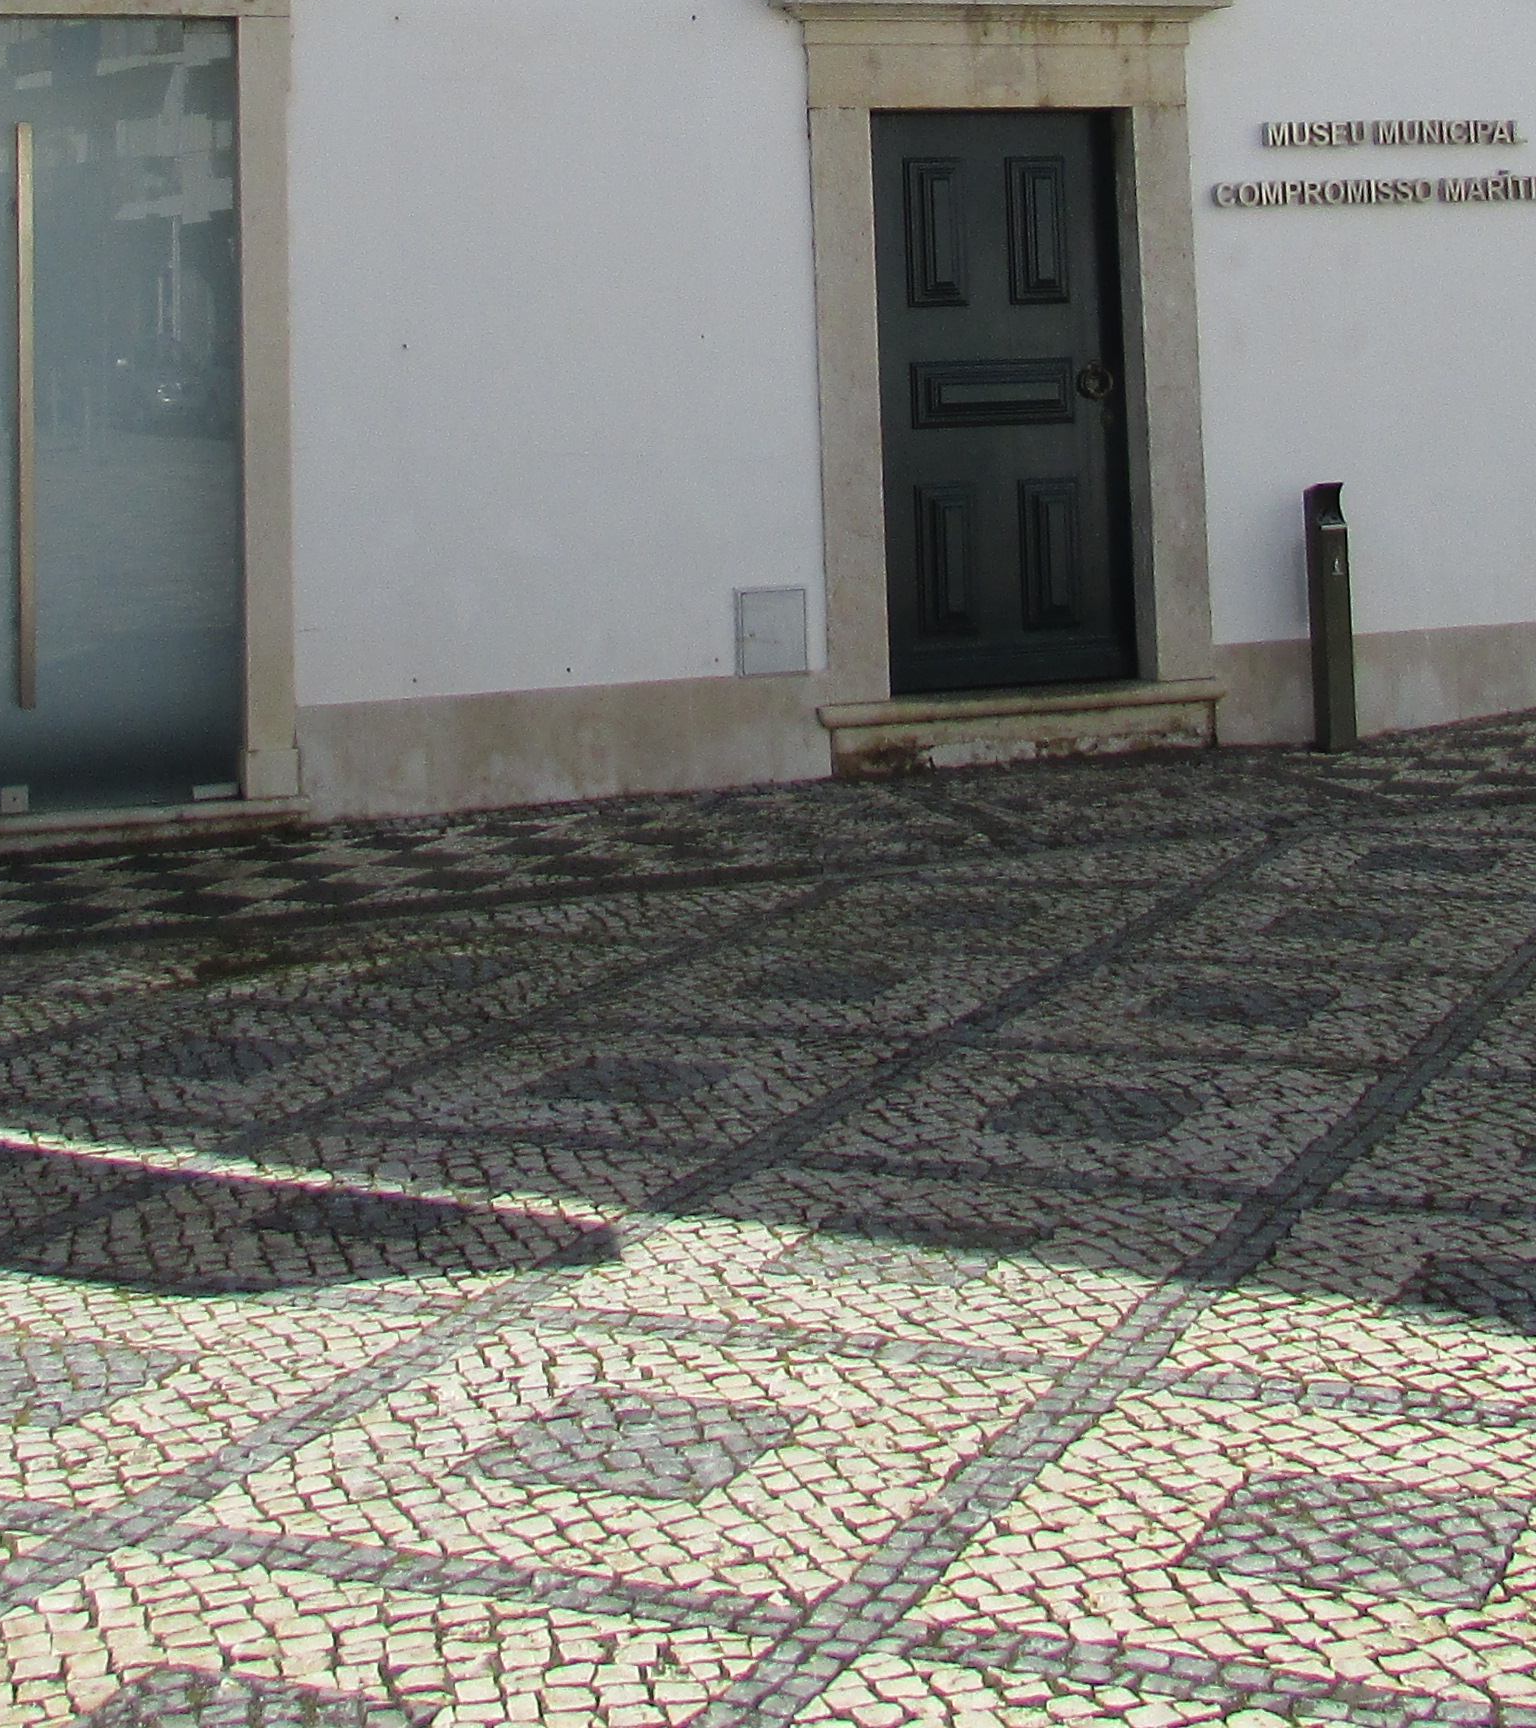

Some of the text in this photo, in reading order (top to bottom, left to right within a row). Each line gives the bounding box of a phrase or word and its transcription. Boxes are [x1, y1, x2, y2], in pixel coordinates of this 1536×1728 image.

[1262, 119, 1527, 147] MUSEU MUNICIPAL
[1212, 178, 1434, 207] COMPROMISSO
